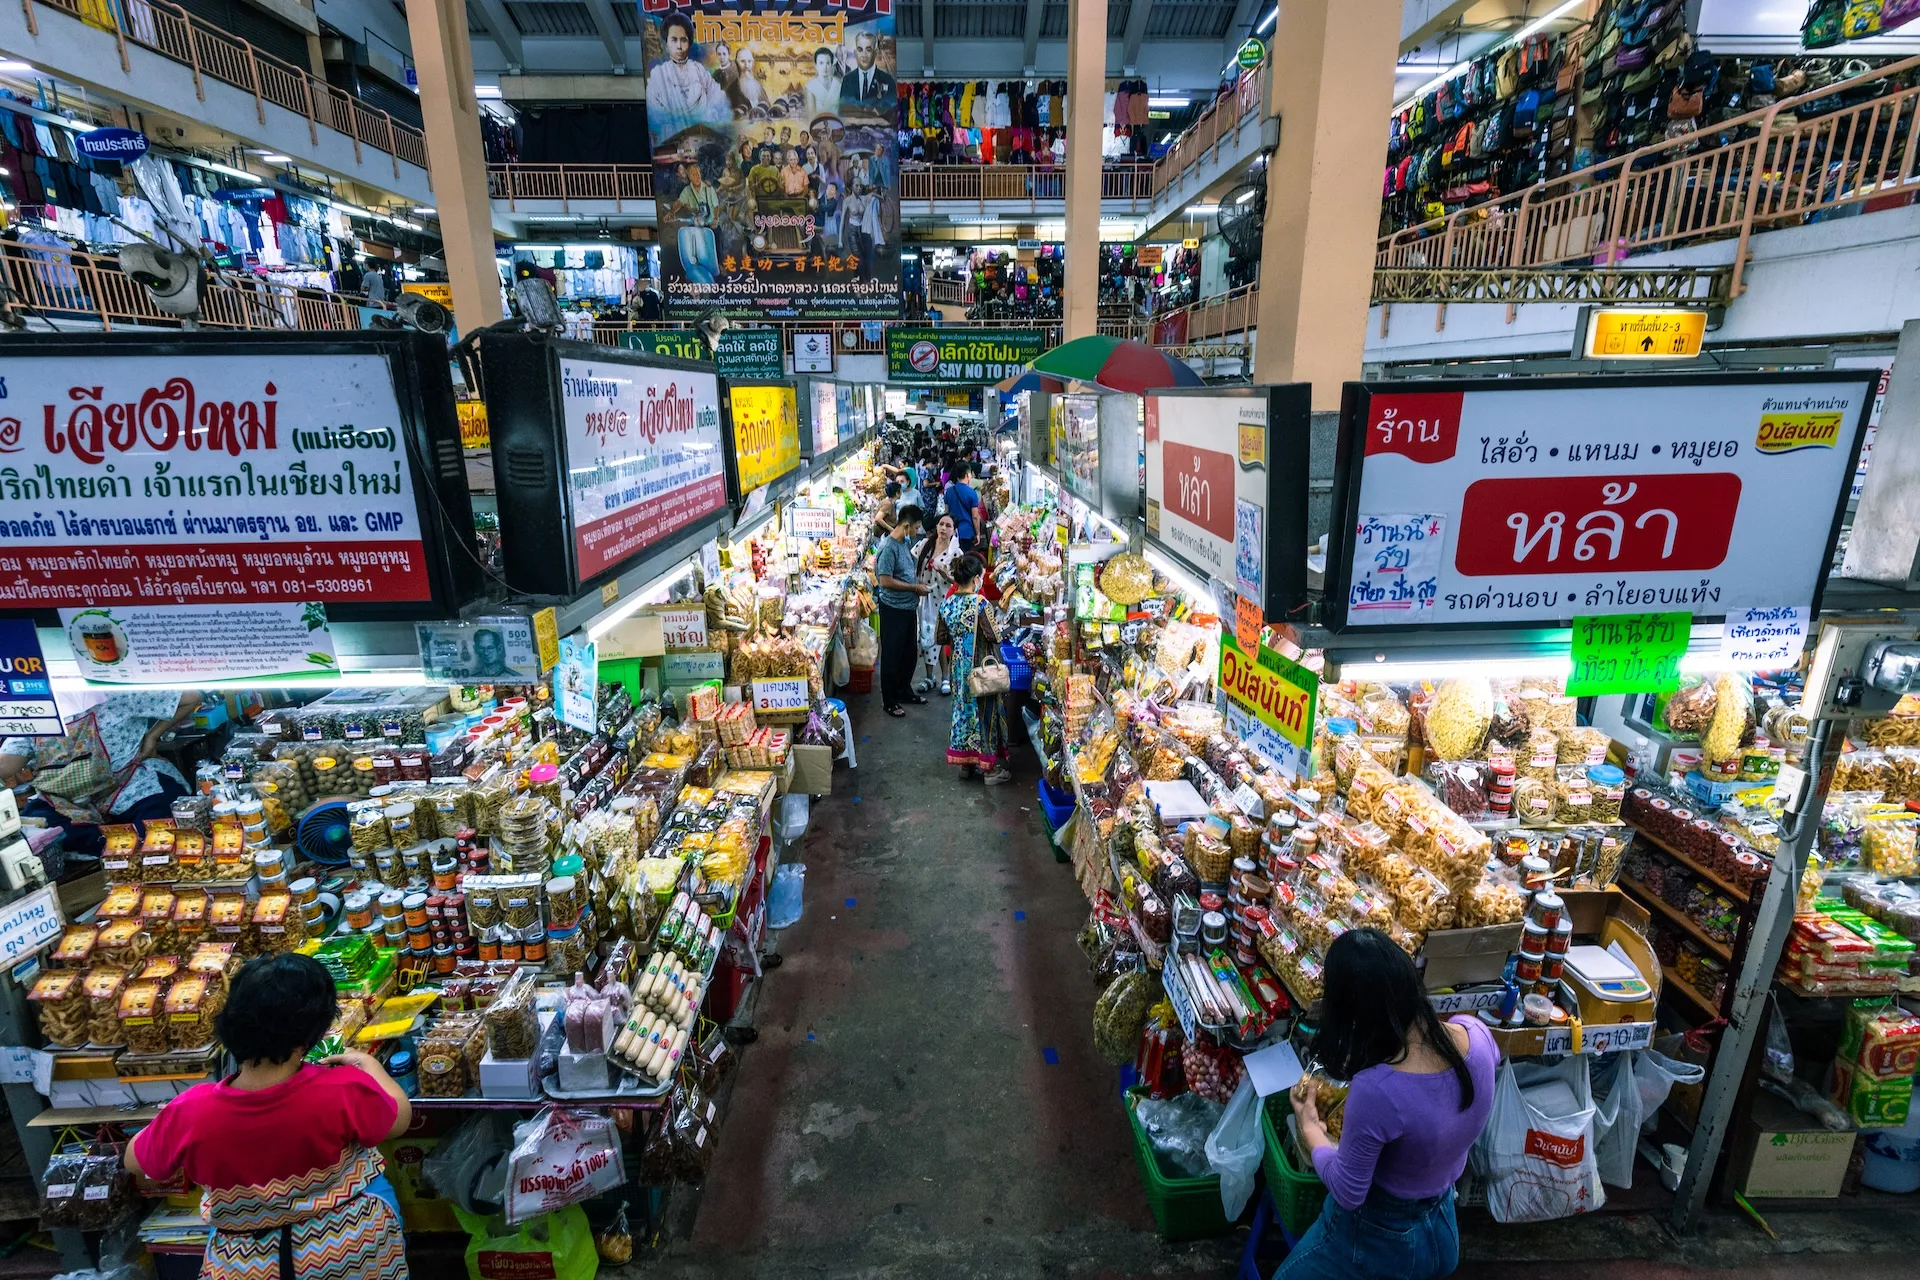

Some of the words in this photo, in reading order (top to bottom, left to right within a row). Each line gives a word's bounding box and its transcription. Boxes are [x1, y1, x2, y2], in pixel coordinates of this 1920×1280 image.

[80, 134, 146, 152] ไทยประสิทธิ์
[718, 340, 745, 353] ลดให้
[750, 339, 777, 352] ลดใช้
[891, 351, 908, 360] เลือก
[939, 342, 1020, 362] เลิกใช้โฟม
[938, 364, 961, 379] SAY
[969, 364, 982, 379] NO
[987, 364, 1000, 378] TO
[563, 368, 618, 406] ร้านน้องนุช
[1762, 397, 1849, 411] ตัวแทนจำหน่าย
[1376, 408, 1440, 443] ร้าน
[1758, 419, 1841, 440] วนัสนันท์
[292, 426, 397, 453] (แม่เฮือง)
[1481, 431, 1538, 464] ไส้อั่ว
[1567, 443, 1637, 462] แหนม
[1671, 436, 1739, 467] หมูยอ
[144, 460, 401, 498] เจ้าแรกในเชียงใหม่
[1178, 454, 1211, 521] หล้า
[57, 510, 178, 537] ไร้สารบอแรกซ์
[183, 510, 290, 540] ผ่านมาตรฐาน
[294, 516, 322, 533] อย.
[328, 514, 359, 532] และ
[365, 512, 404, 532] GMP
[1505, 481, 1680, 563] หล้า
[26, 550, 140, 577] หมูยอพริกไทยดำ
[145, 548, 238, 575] หมูยอหนังหมู
[243, 546, 334, 574] หมูยอหมูล้วน
[338, 549, 412, 573] หมูยอหูหมู
[1374, 547, 1410, 571] รับ
[283, 579, 373, 595] 081-5308961
[1444, 585, 1557, 610] รถด่วนอบ
[1585, 579, 1721, 607] ลำไยอบแห้ง
[508, 630, 527, 638] 500
[762, 682, 799, 696] แคบหมู
[1223, 651, 1308, 732] วนัสนันท์
[760, 699, 769, 708] 3
[770, 698, 784, 708] ถุง
[786, 698, 802, 707] 100
[1470, 993, 1499, 1009] 100
[584, 1149, 609, 1176] 100%
